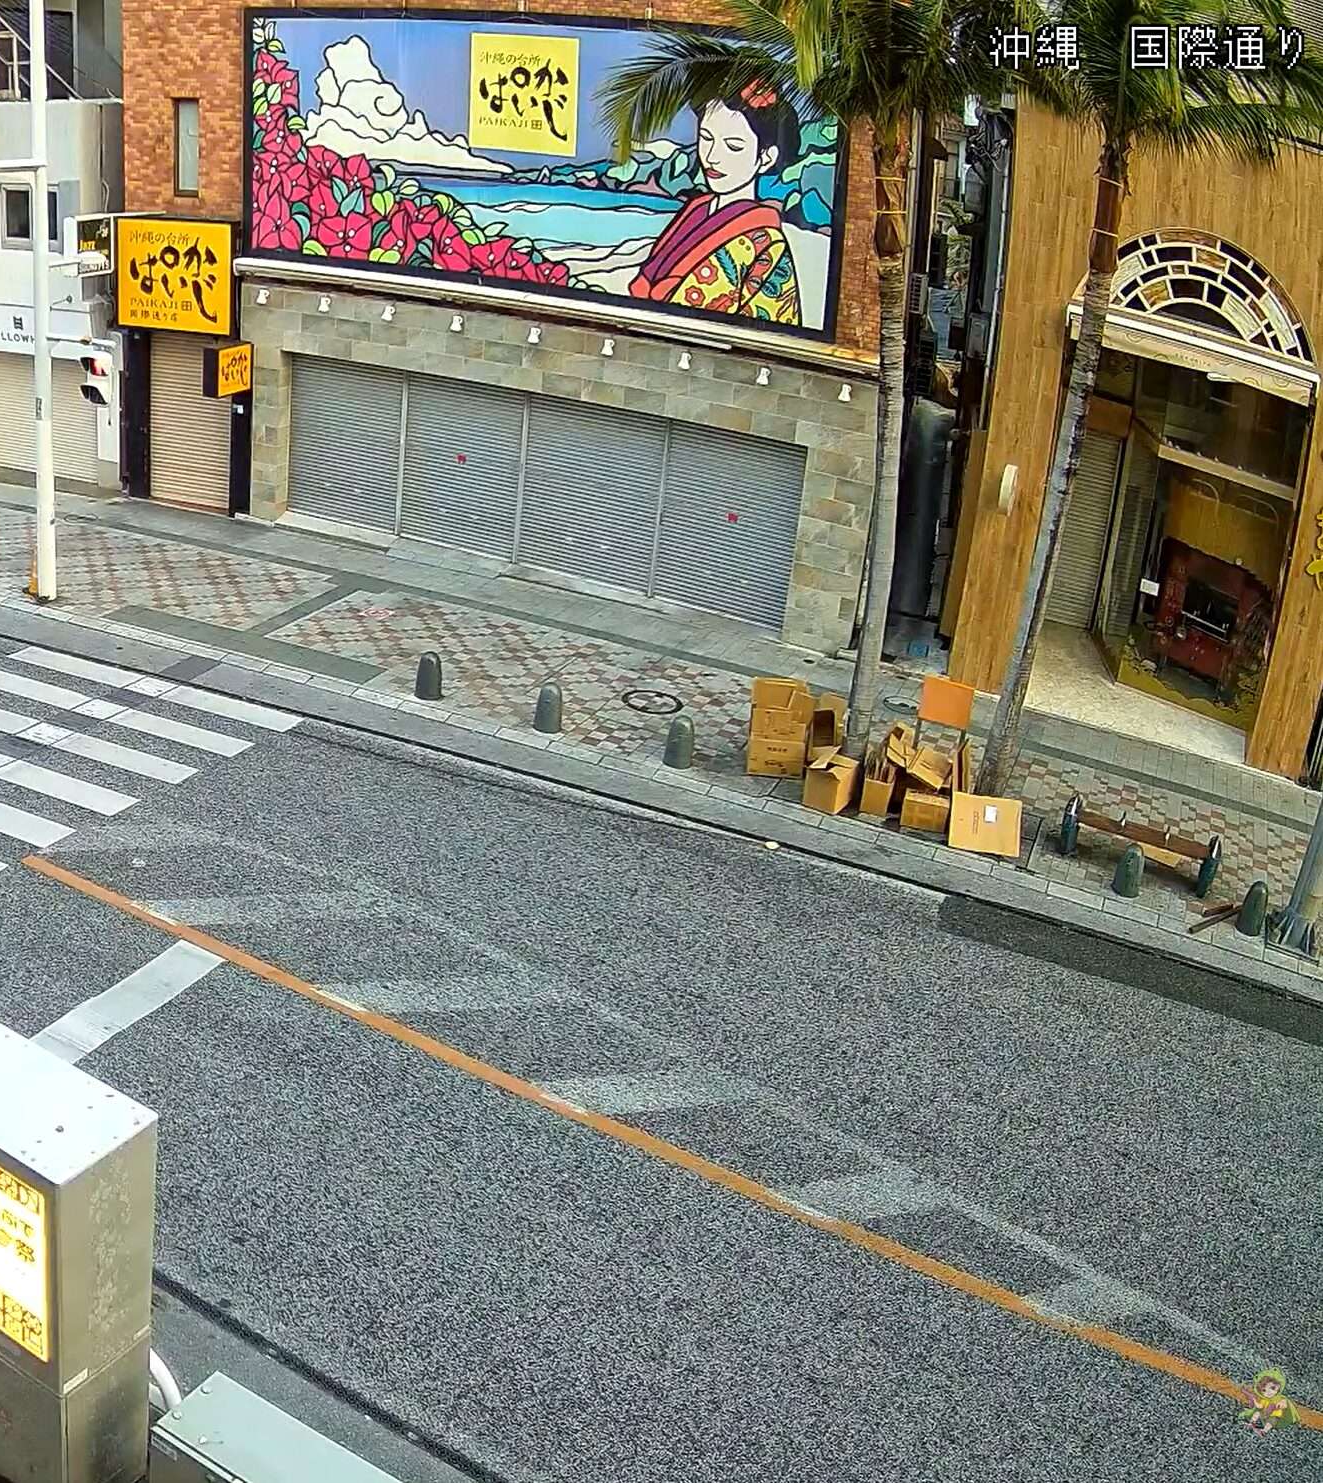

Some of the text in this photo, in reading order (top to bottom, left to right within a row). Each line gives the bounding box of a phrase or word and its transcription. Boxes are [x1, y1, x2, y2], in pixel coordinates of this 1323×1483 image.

[480, 51, 542, 66] 沖縄の台所
[479, 116, 529, 128] PAIKAJI
[130, 230, 190, 246] 沖縄の台所
[130, 298, 178, 310] PAIKAJI
